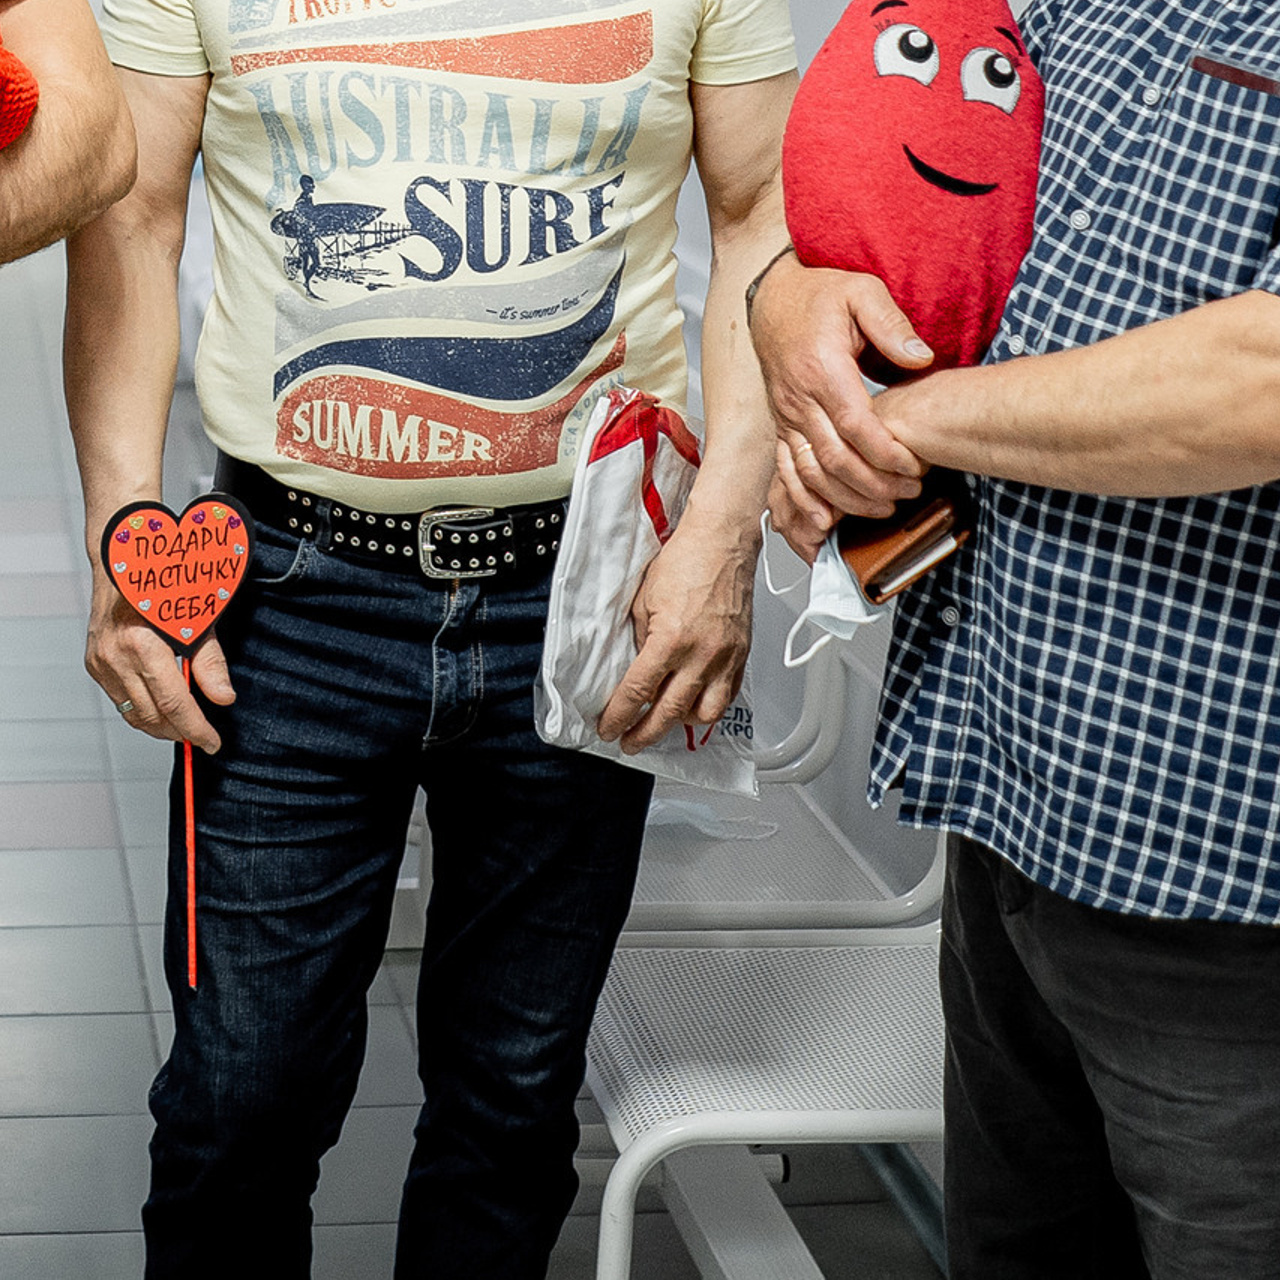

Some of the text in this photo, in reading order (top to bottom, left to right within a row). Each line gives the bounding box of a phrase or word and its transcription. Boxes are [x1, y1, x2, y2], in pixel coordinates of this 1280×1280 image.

[246, 70, 652, 212] AUSTRALIA
[398, 170, 626, 283] SURF
[292, 399, 495, 464] SUMMER
[134, 524, 229, 562] ПОДАРИ
[128, 556, 241, 593] ЧАСТИЧКУ
[158, 593, 216, 622] СЕБЯ
